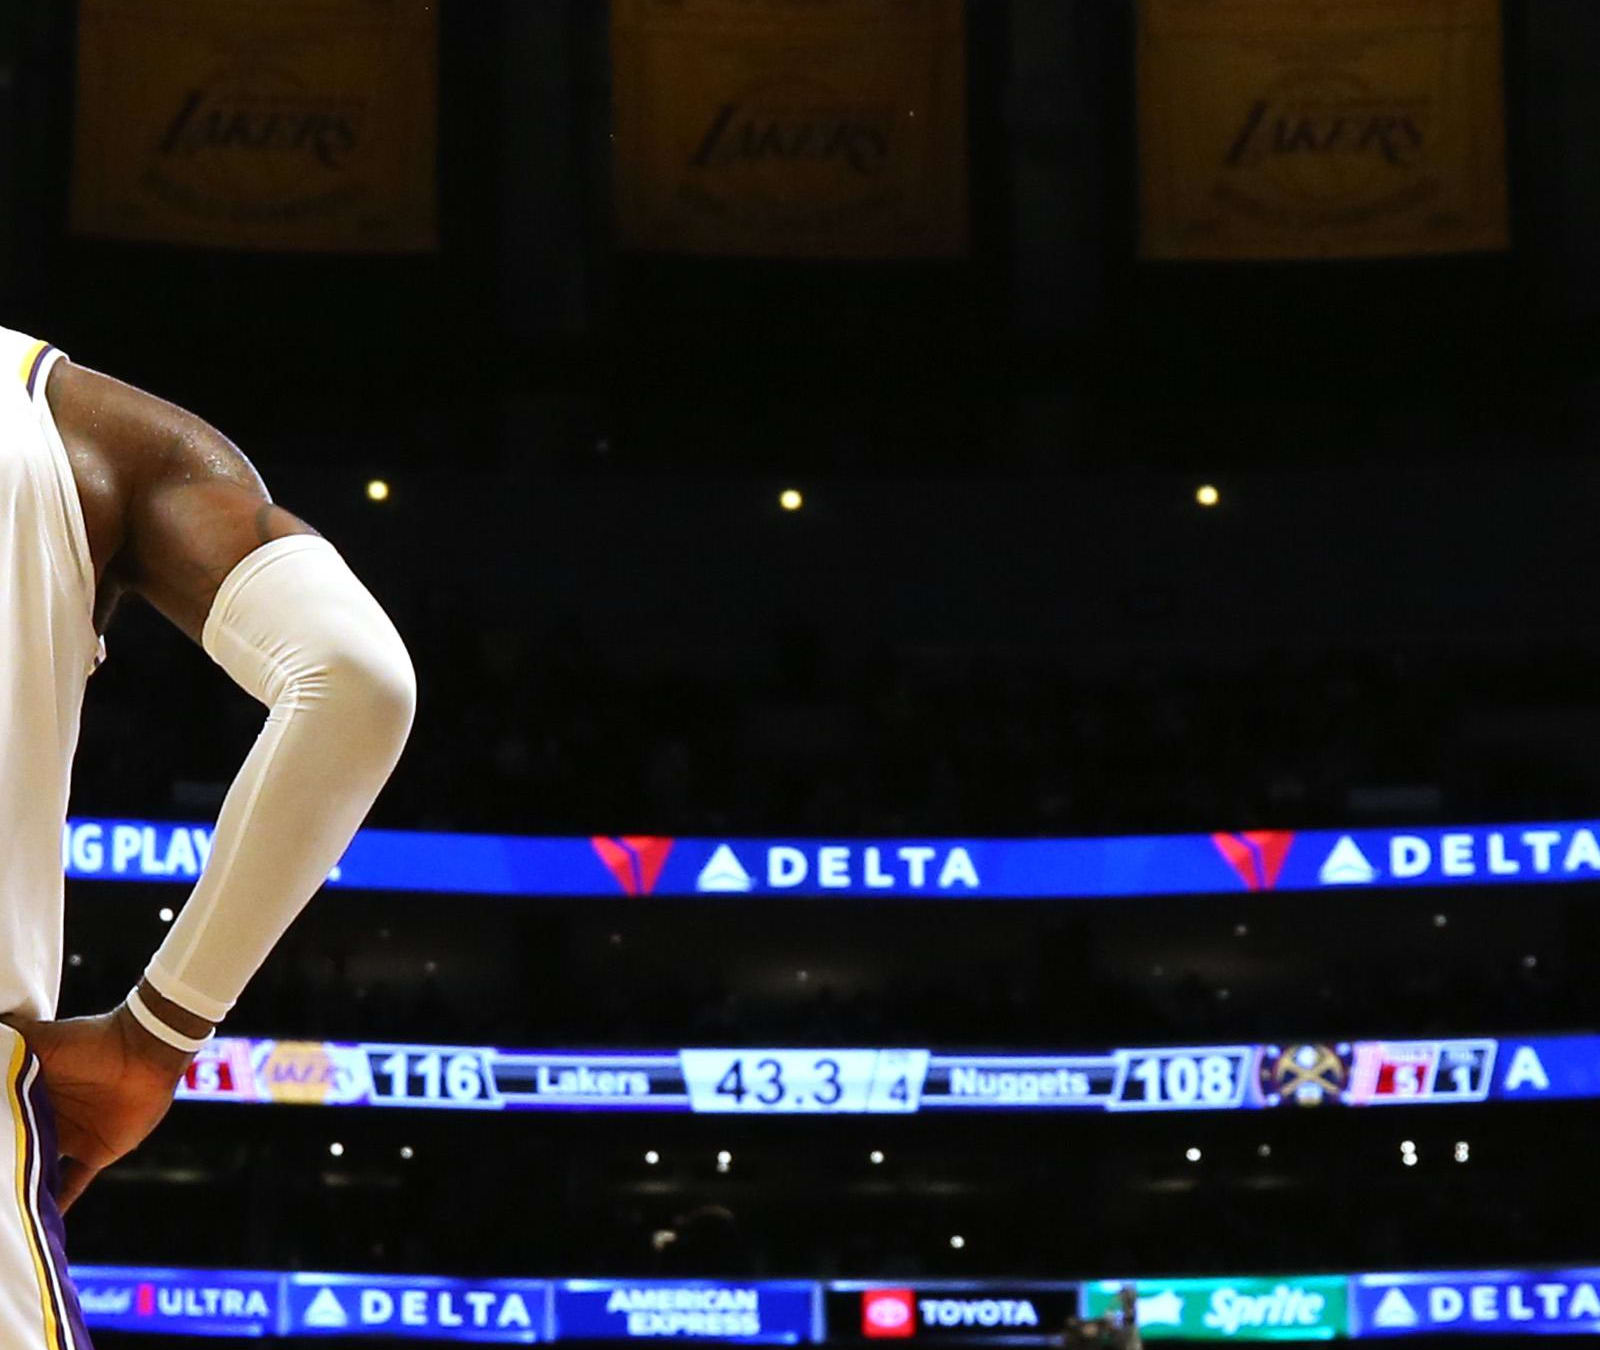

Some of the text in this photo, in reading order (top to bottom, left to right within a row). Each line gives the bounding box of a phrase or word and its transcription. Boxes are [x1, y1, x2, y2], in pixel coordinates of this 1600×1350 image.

[768, 845, 979, 888] DELTA
[379, 1051, 479, 1099] 116
[536, 1064, 651, 1098] Lakers
[717, 1059, 844, 1109] 43.3
[949, 1065, 1090, 1102] Nuggets
[1134, 1056, 1238, 1104] 108
[158, 1288, 270, 1318] ULTRA
[360, 1289, 532, 1329] DELTA
[607, 1289, 760, 1313] AMERICAN
[920, 1300, 1039, 1327] TOYOTA
[1203, 1286, 1325, 1335] Sprite
[628, 1310, 761, 1336] EXPRESS
